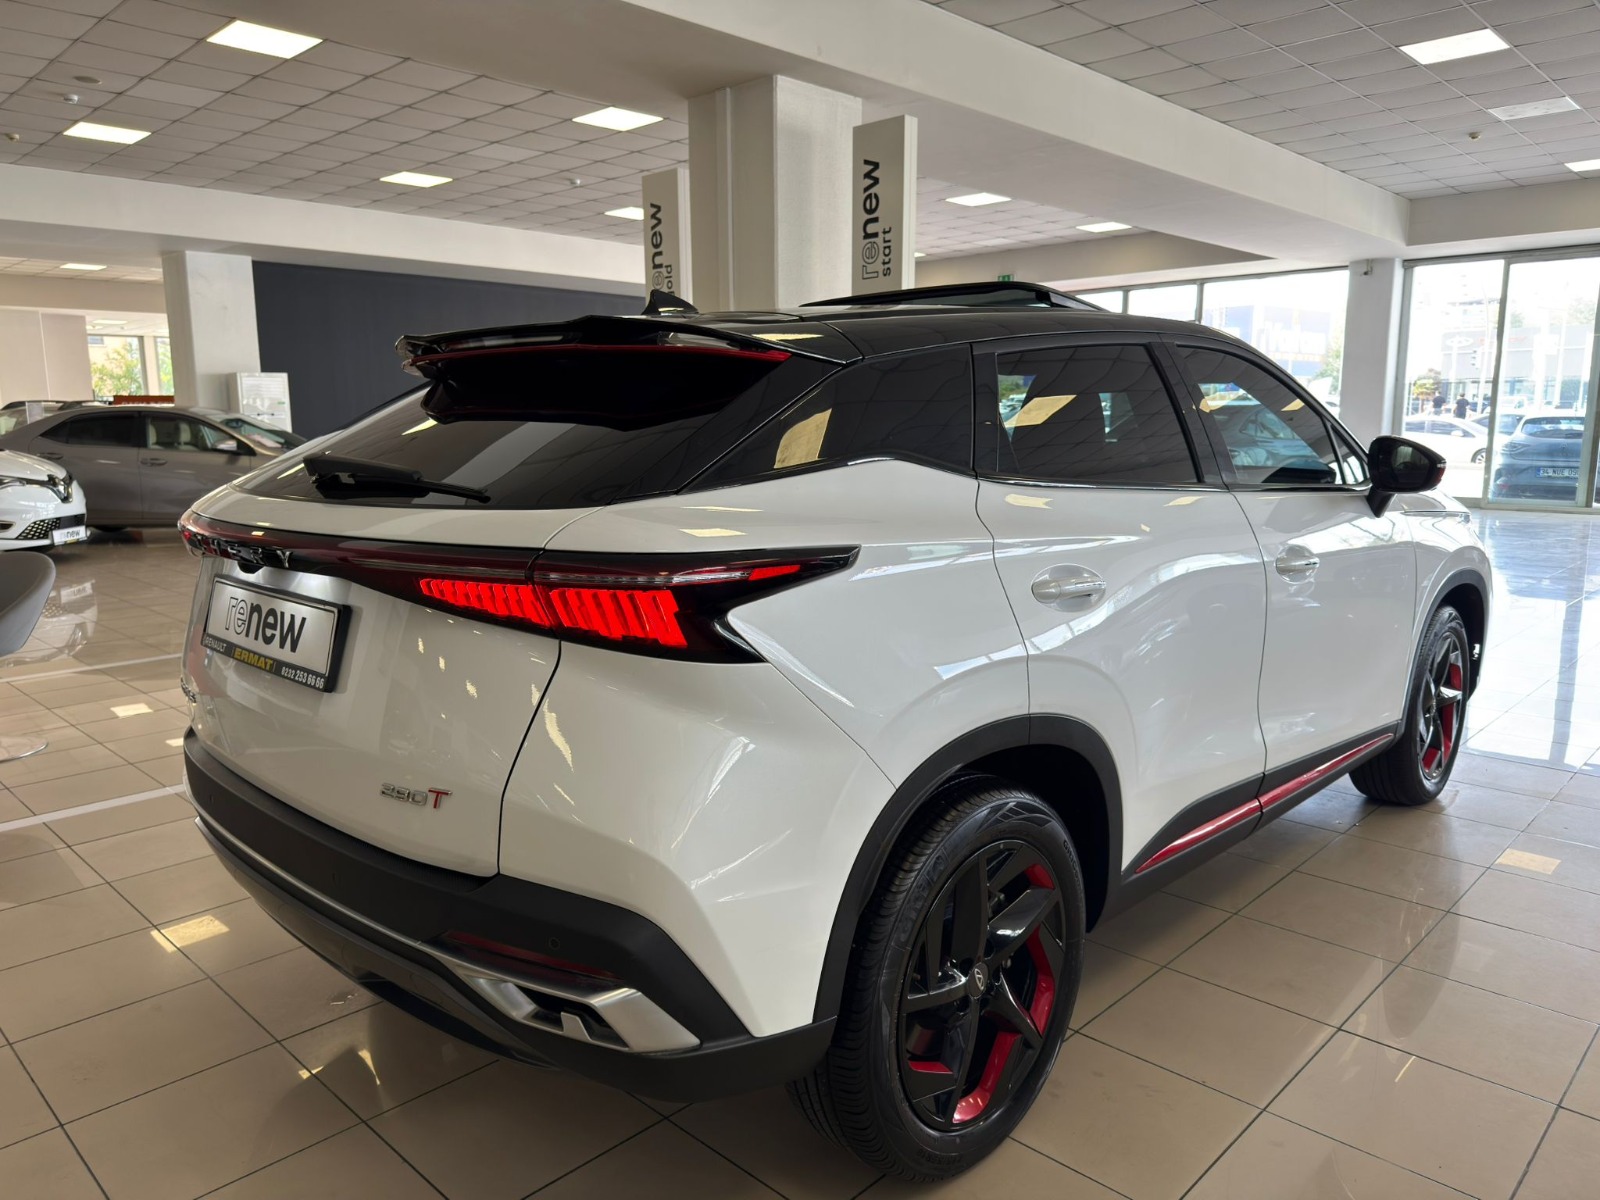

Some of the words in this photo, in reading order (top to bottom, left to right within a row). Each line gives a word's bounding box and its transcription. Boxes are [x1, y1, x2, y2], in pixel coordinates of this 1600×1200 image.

[650, 202, 665, 291] enew
[862, 159, 880, 280] renew
[882, 226, 892, 277] start
[225, 596, 307, 654] renew
[205, 636, 227, 652] RENAULT
[233, 647, 274, 671] ERMAT
[281, 666, 295, 679] 0232
[295, 670, 307, 683] 253
